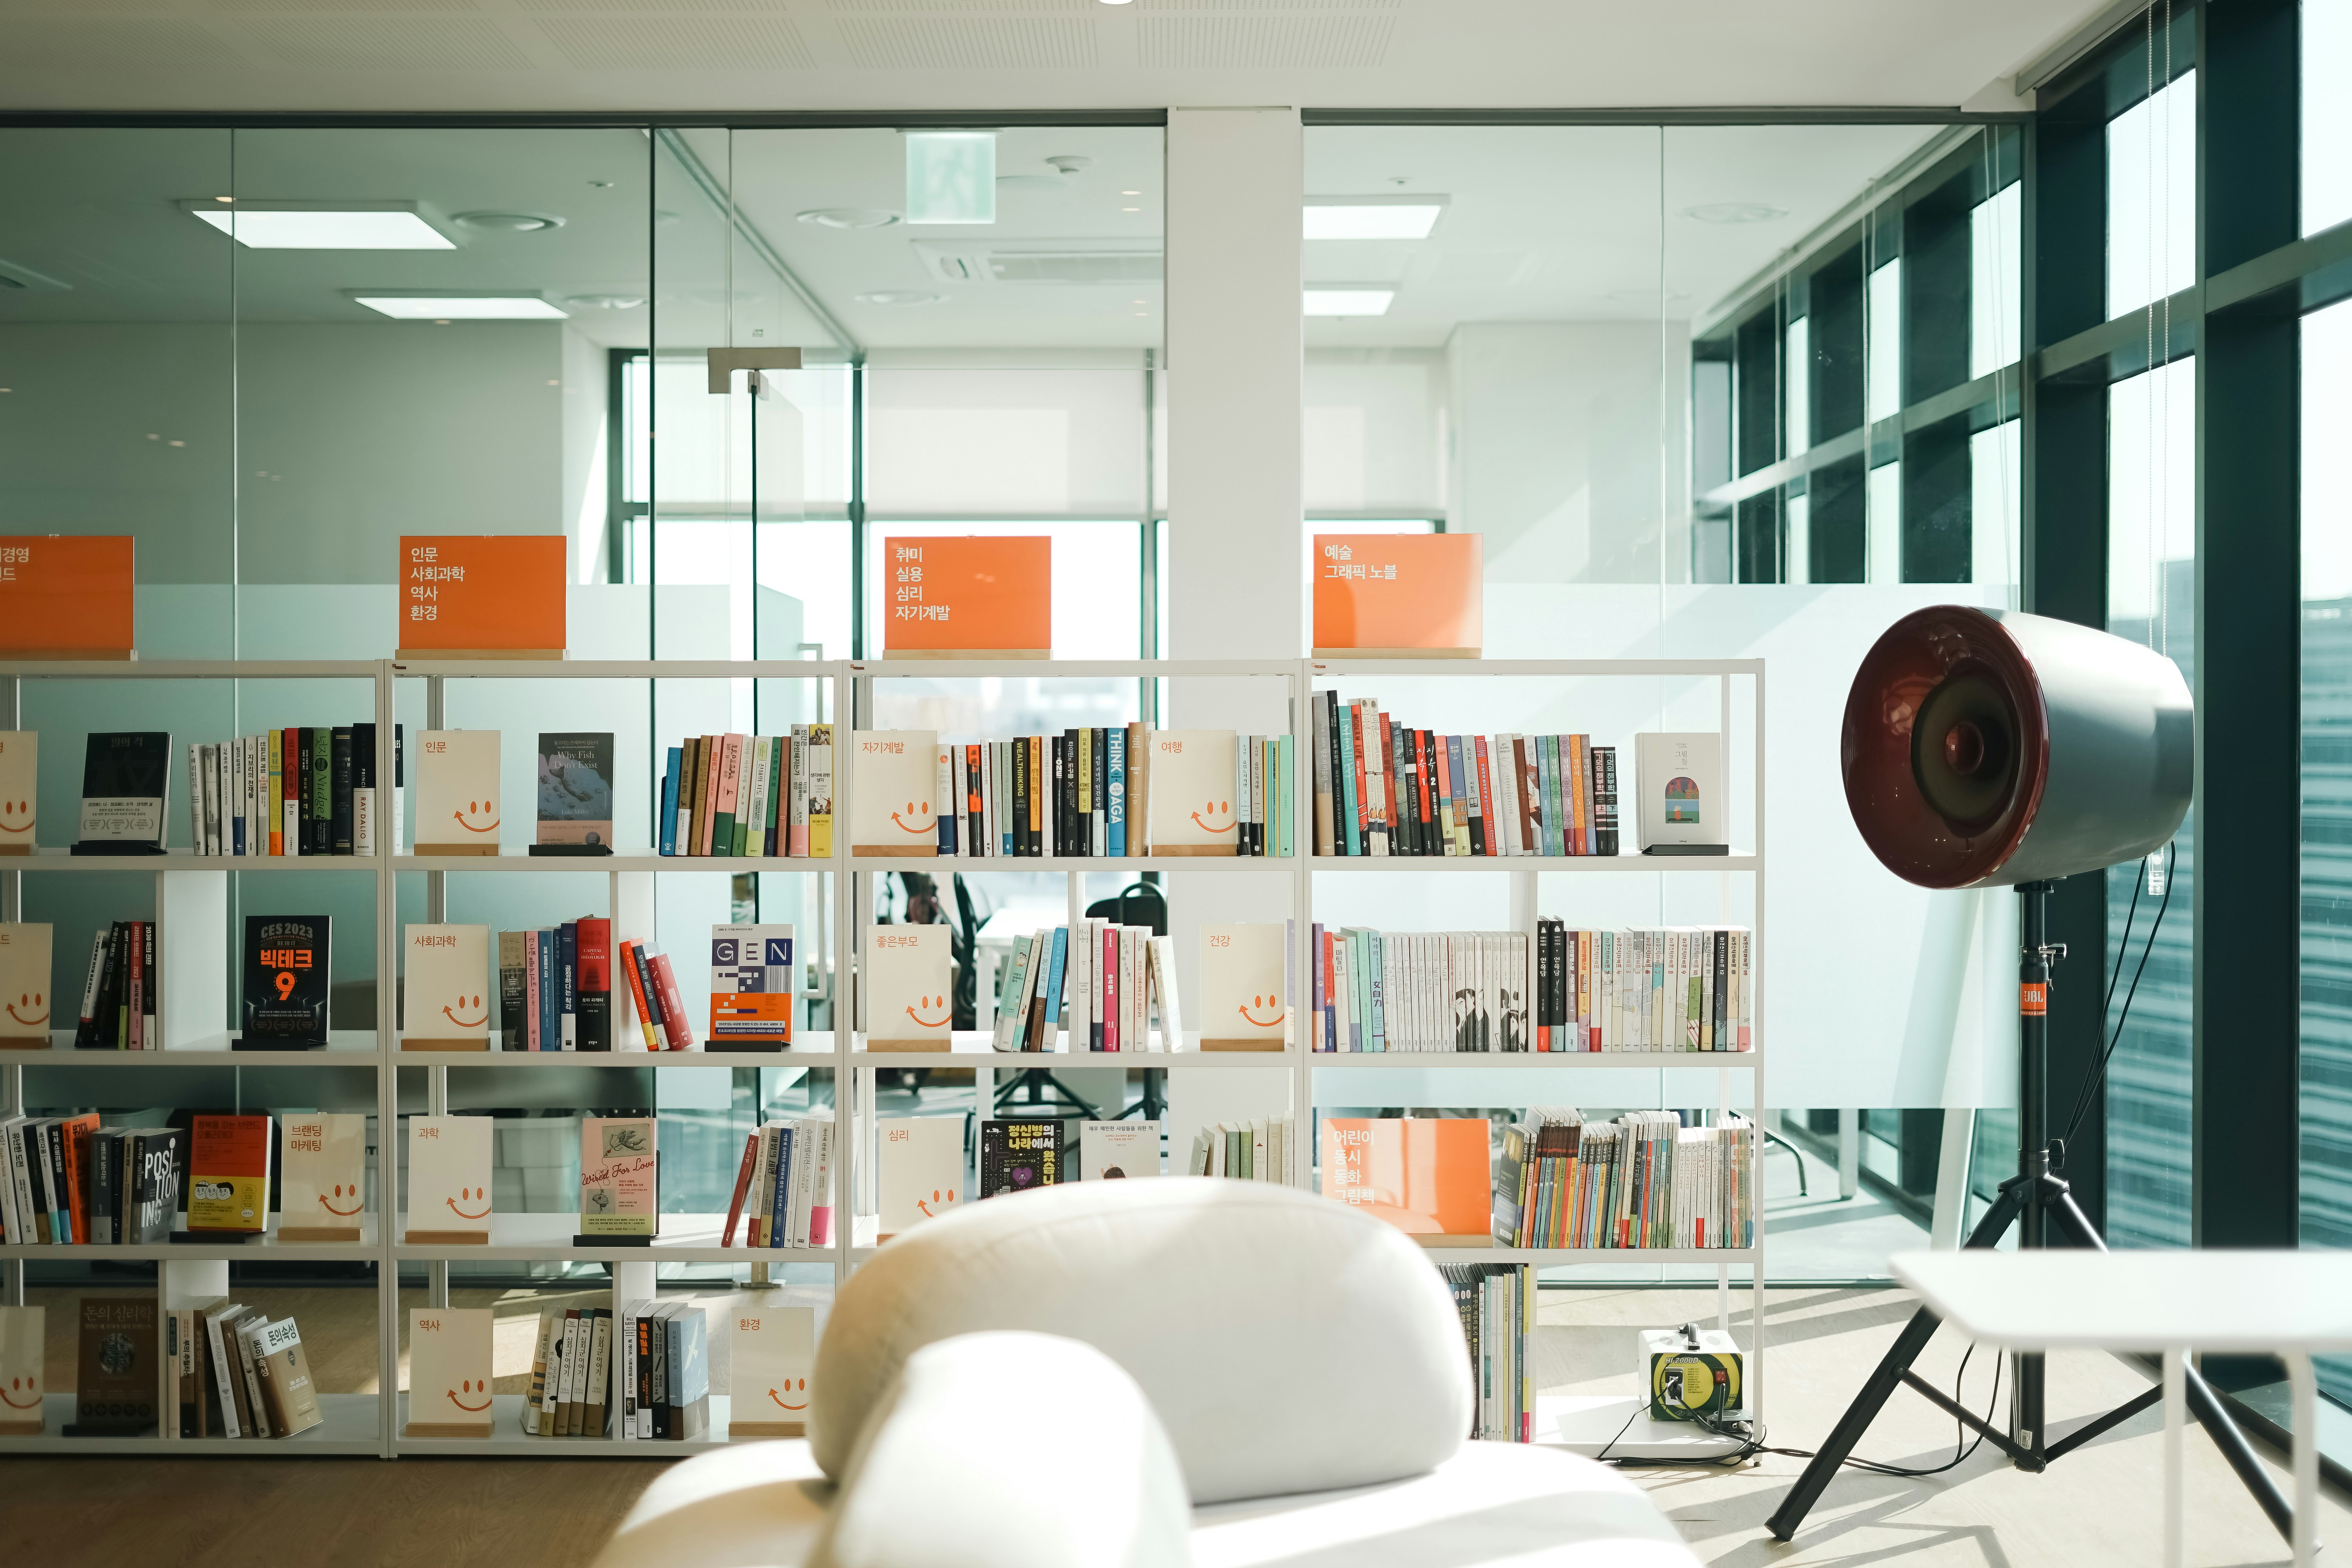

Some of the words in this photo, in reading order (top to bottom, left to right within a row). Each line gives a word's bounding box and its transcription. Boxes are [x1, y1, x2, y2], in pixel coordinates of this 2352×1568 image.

[0, 547, 29, 563] 경영
[410, 547, 437, 563] 인문
[896, 547, 922, 562] 취미
[1325, 544, 1352, 560] 예술
[410, 566, 465, 582] 사회과학
[896, 566, 923, 582] 실용
[1324, 564, 1365, 580] 그래픽
[1369, 564, 1397, 580] 노블
[410, 586, 438, 602] 역사
[896, 586, 922, 601] 심리
[410, 605, 437, 621] 환경
[895, 605, 950, 621] 자기계발
[1352, 714, 1361, 740] MODERN
[315, 735, 328, 757] 넛지
[426, 741, 446, 753] 인문
[862, 742, 904, 754] 자기계발
[1083, 738, 1087, 746] 아주
[1161, 741, 1182, 753] 여행
[1333, 739, 1338, 750] 뉴욕
[558, 751, 576, 760] Why
[1111, 732, 1122, 773] THINK
[260, 763, 266, 773] 게임
[1431, 777, 1436, 786] 2
[315, 773, 328, 813] Nudge
[261, 923, 283, 938] CES
[285, 923, 313, 938] 2023
[414, 935, 457, 947] 사회과학
[877, 936, 919, 948] 좋은부모
[1210, 935, 1231, 947] 건강
[261, 949, 312, 968] 빅테크
[717, 942, 786, 961] GEN
[274, 971, 296, 1000] 9
[1373, 981, 1382, 1007] 女自力
[2024, 991, 2043, 1002] JBL
[565, 997, 572, 1010] 착각
[197, 1120, 219, 1129] 행복을
[222, 1120, 236, 1129] 파는
[291, 1125, 322, 1136] 브랜딩
[1008, 1125, 1055, 1136] 정신병의
[418, 1127, 440, 1140] 과학
[888, 1129, 909, 1142] 심리
[1333, 1130, 1374, 1145] 어린이
[12, 1132, 22, 1154] 유난한
[291, 1140, 321, 1152] 마케팅
[804, 1129, 813, 1171] 슈퍼인텔리전스
[1009, 1138, 1054, 1149] 나라에서
[15, 1155, 24, 1168] 도전
[1334, 1149, 1360, 1165] 동시
[582, 1169, 609, 1185] Wired
[612, 1163, 630, 1178] For
[633, 1158, 654, 1171] Love
[1043, 1151, 1055, 1185] 왔습니
[1334, 1169, 1361, 1185] 동화
[1334, 1189, 1374, 1204] 그림책
[83, 1306, 111, 1321] 돈의
[114, 1306, 153, 1322] 심리학
[419, 1319, 441, 1332] 역사
[739, 1318, 760, 1331] 환경
[183, 1339, 190, 1353] 부의
[252, 1339, 265, 1357] 돈의
[257, 1358, 269, 1377] 속성
